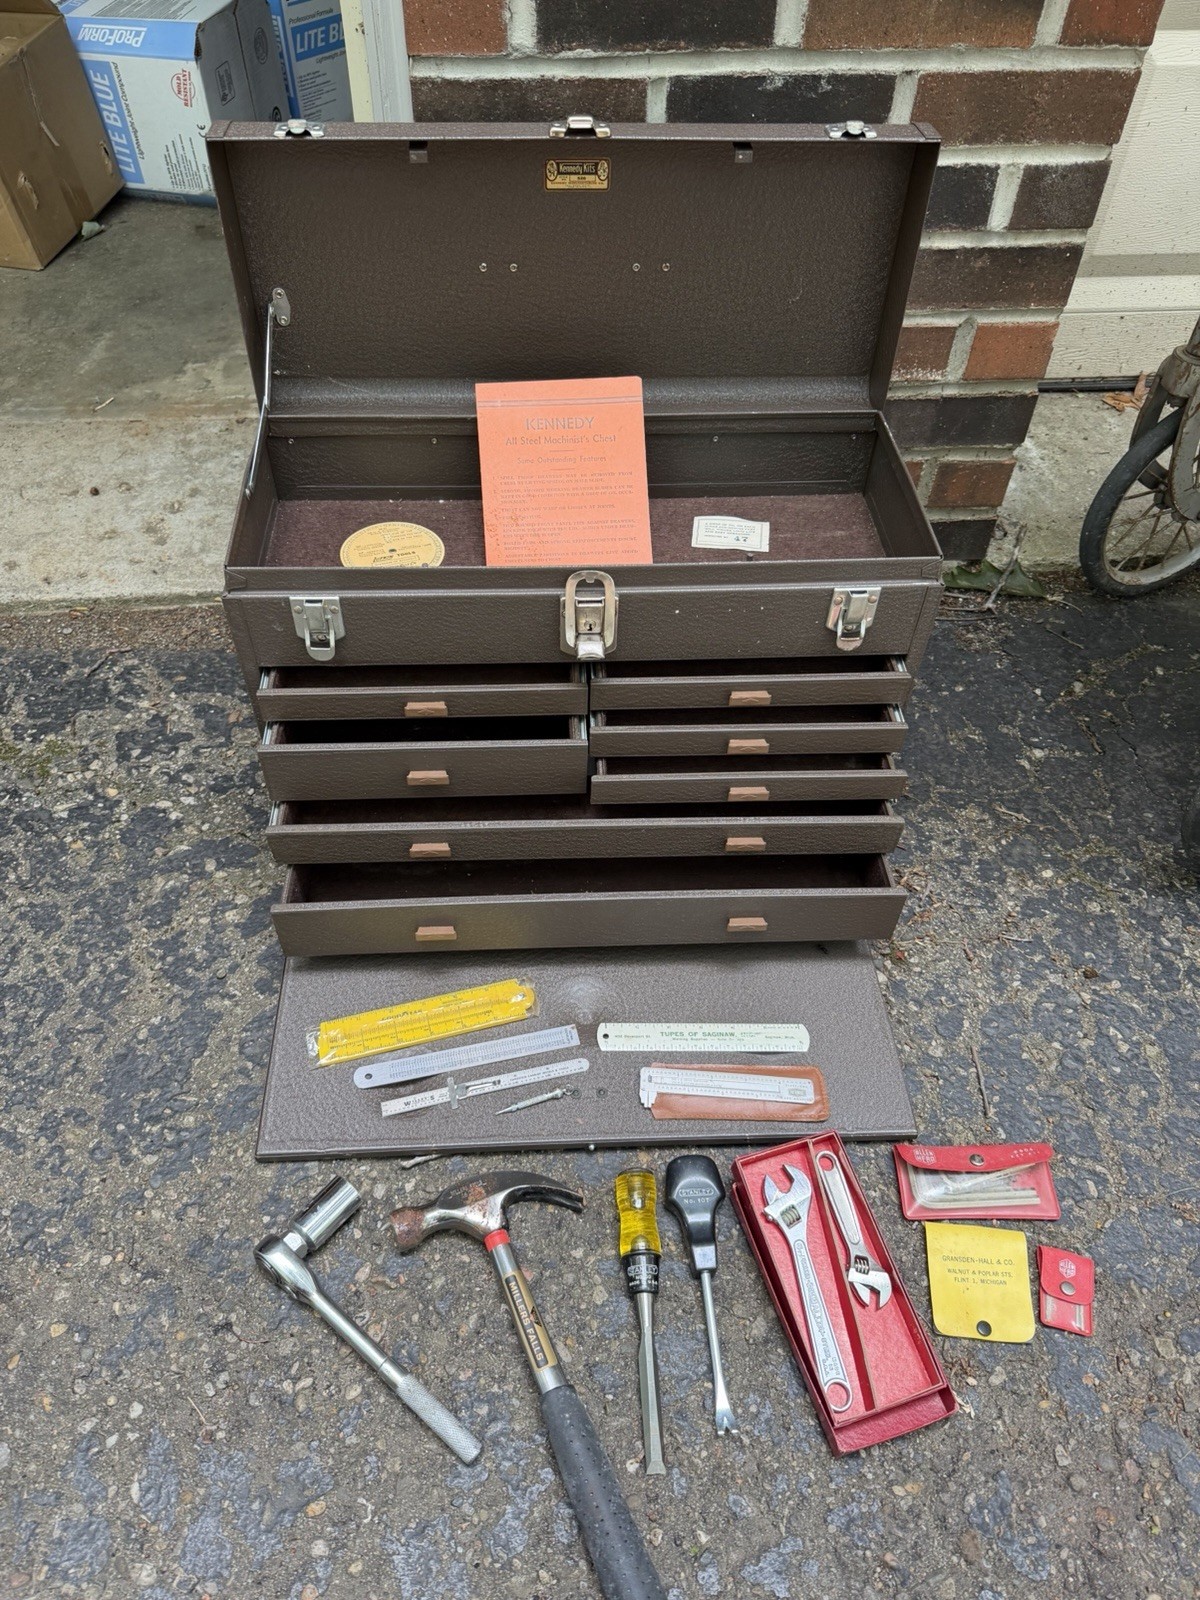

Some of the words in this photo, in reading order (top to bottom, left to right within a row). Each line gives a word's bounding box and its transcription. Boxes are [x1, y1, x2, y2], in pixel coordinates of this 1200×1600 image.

[296, 27, 326, 53] LITE
[111, 61, 129, 103] Compound
[181, 68, 190, 107] RESISTANT
[90, 69, 122, 127] BLUE
[109, 130, 136, 174] LITE
[559, 163, 582, 174] Kennedy
[583, 163, 596, 173] Kits
[525, 417, 594, 430] KENNEDY
[505, 437, 519, 446] All
[521, 436, 541, 445] Steel
[543, 435, 590, 445] Machinist's
[592, 434, 617, 443] Chest
[537, 456, 577, 465] Outstanding
[680, 1188, 713, 1196] STANLEY
[942, 1255, 994, 1265] GRANSDEN-HALL
[508, 1281, 531, 1326] MILLERS
[526, 1328, 544, 1361] FALLS
